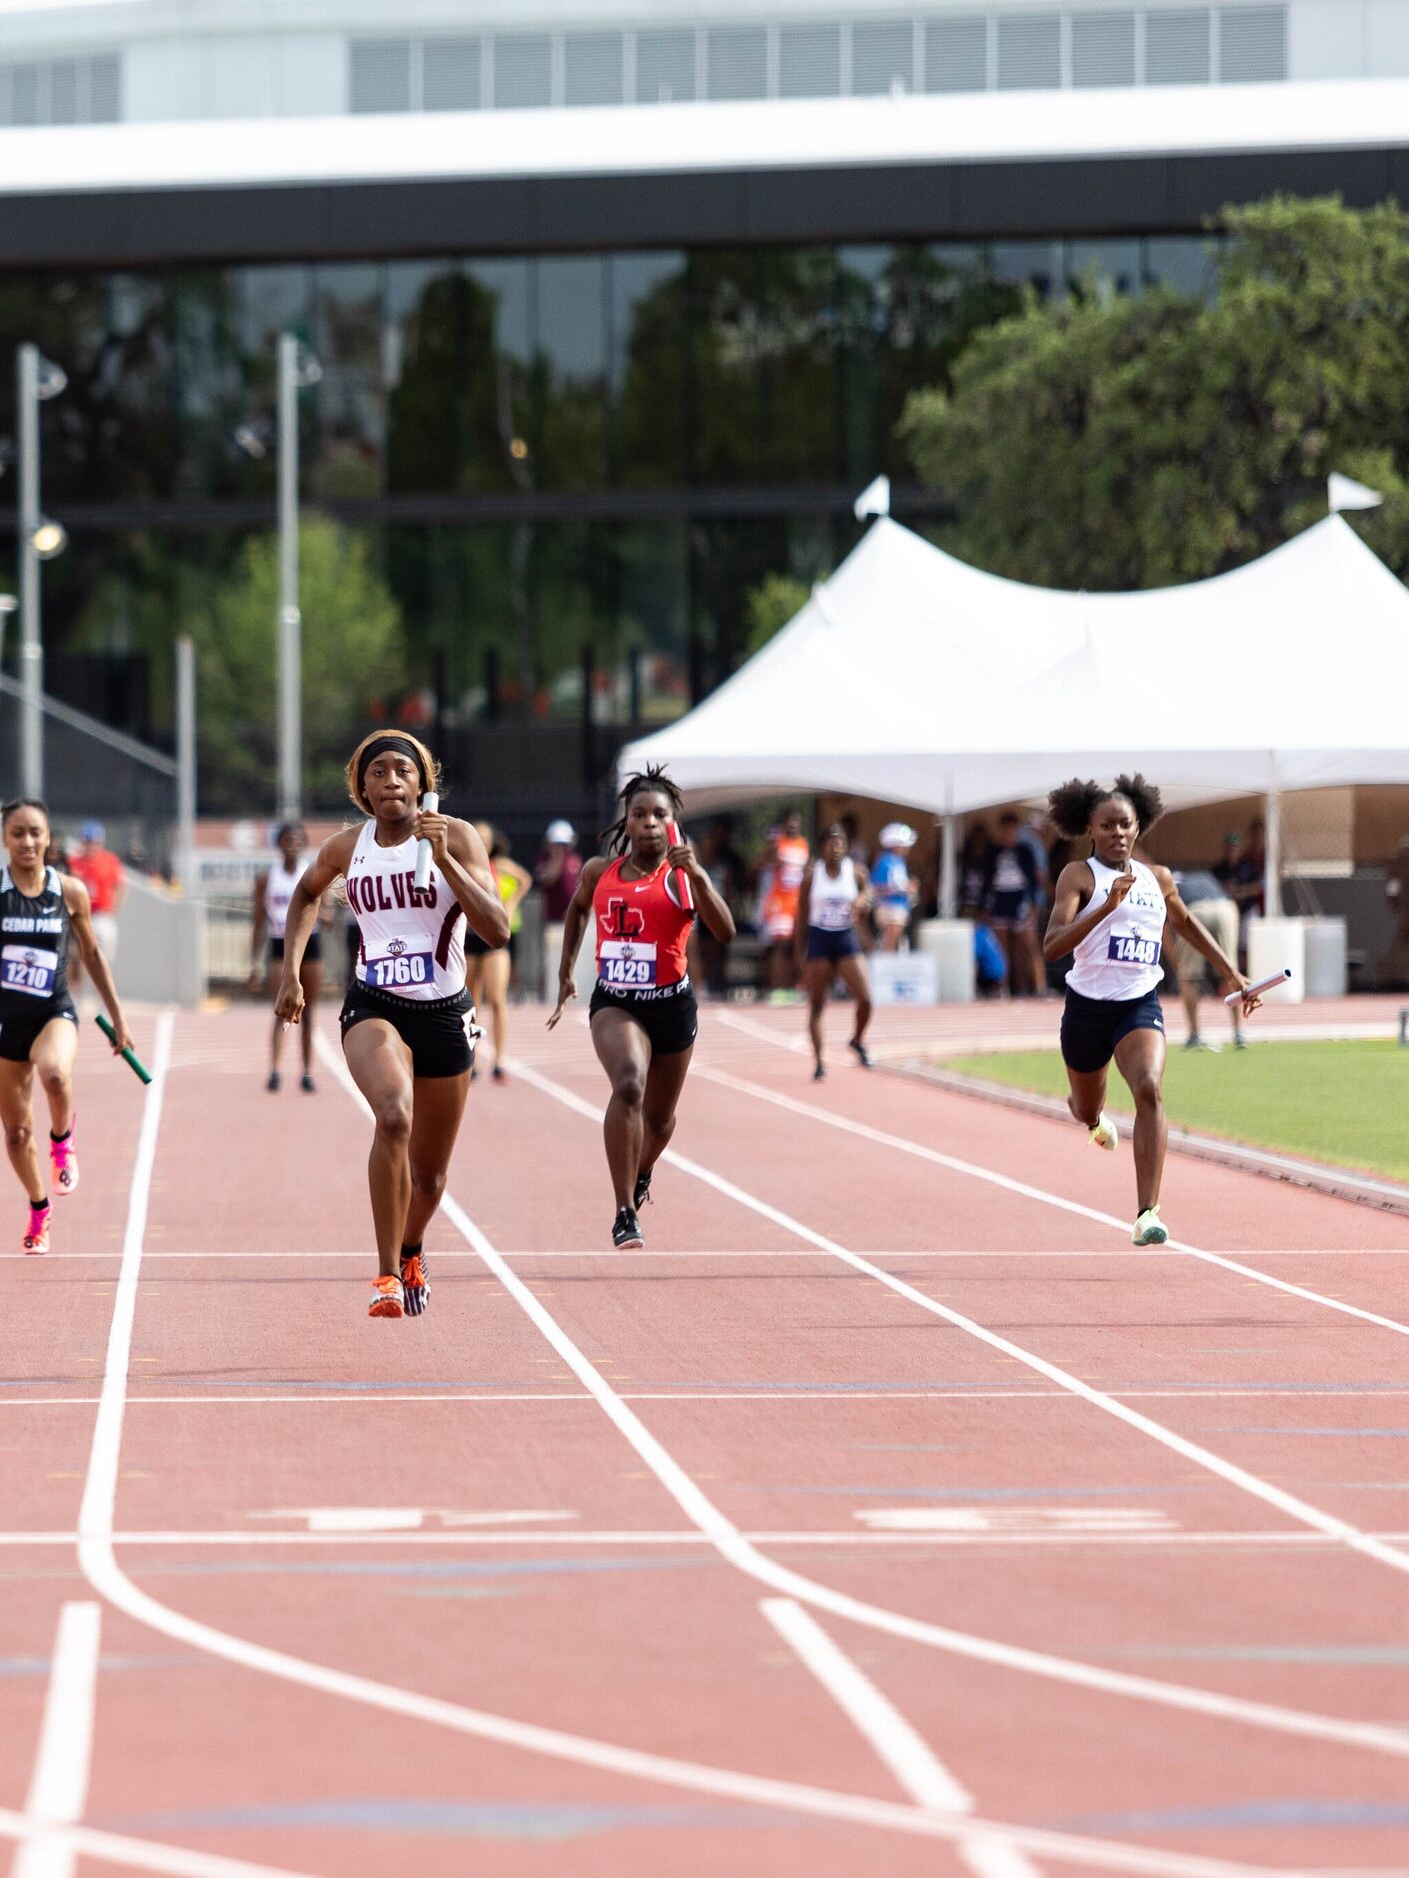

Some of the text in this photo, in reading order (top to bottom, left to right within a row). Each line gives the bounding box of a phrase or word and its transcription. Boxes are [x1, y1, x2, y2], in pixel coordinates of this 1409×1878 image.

[2, 917, 62, 933] CEDAR PARK
[7, 962, 48, 989] 1210
[374, 956, 426, 985] 1760
[606, 960, 650, 983] 1429
[634, 984, 674, 1001] NIKE
